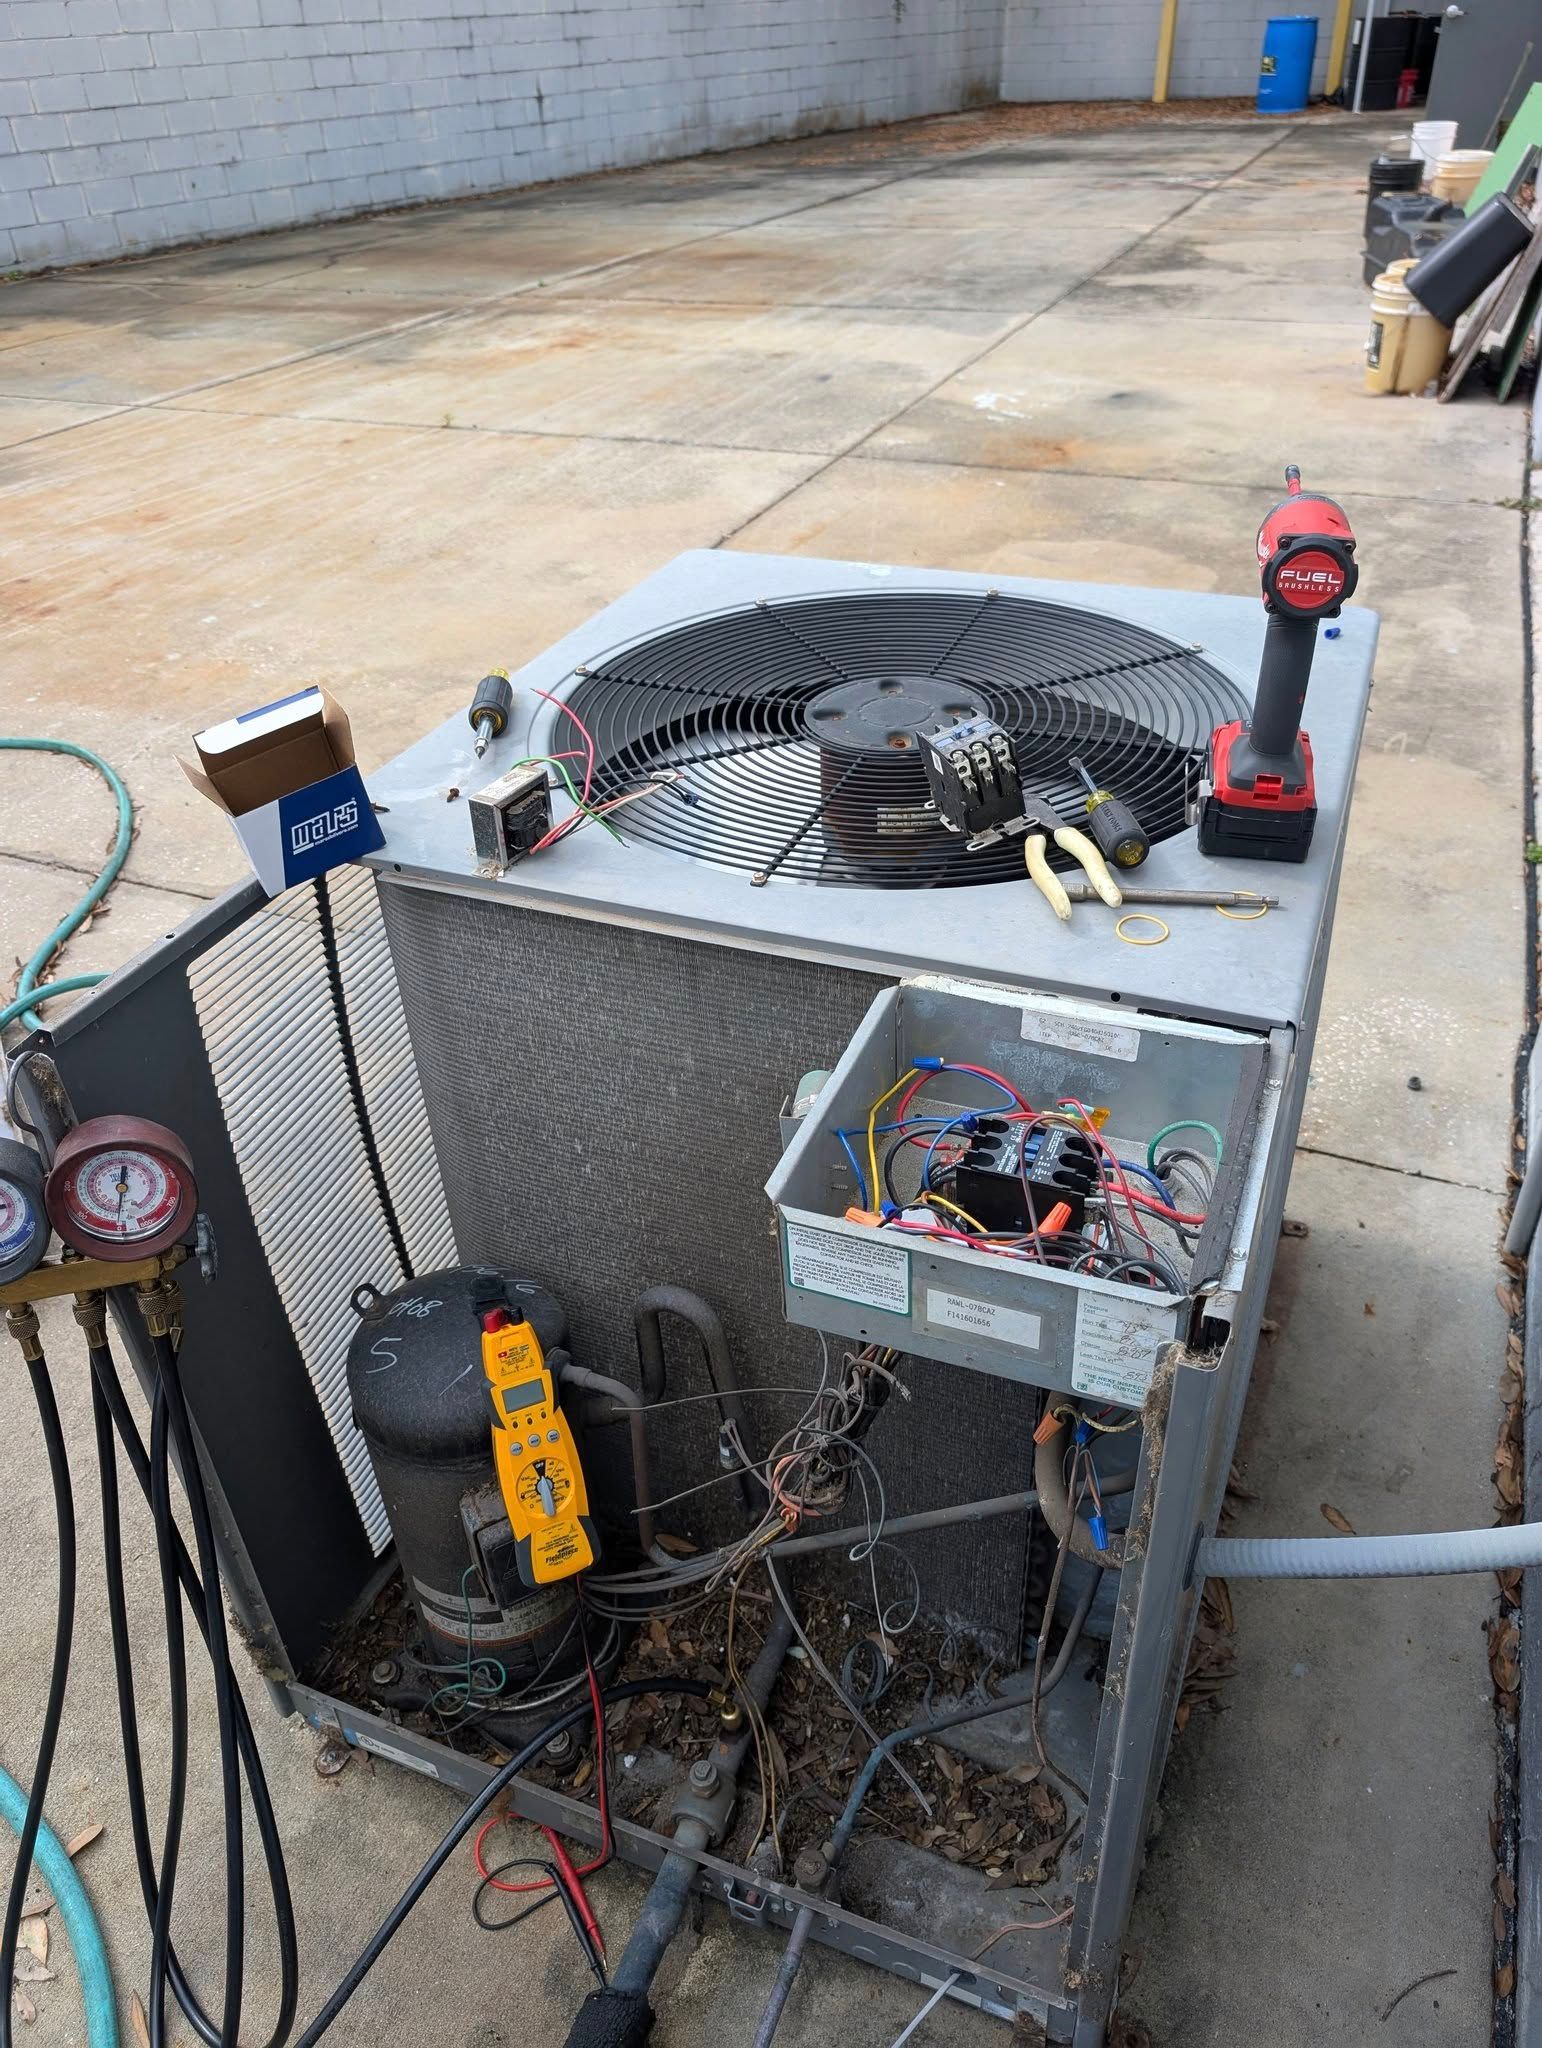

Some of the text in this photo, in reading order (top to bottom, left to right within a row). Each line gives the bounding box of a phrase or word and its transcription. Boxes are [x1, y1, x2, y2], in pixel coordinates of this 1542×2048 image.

[1280, 570, 1341, 584] FUEL
[1278, 582, 1340, 592] BRUSHLESS
[76, 1210, 88, 1220] 100
[947, 1297, 996, 1316] RAWL-078CAZ
[947, 1310, 991, 1328] F141601656
[1097, 1375, 1114, 1384] NEXT
[1117, 1380, 1145, 1391] INSPECT
[1112, 1383, 1143, 1396] CUSTOM
